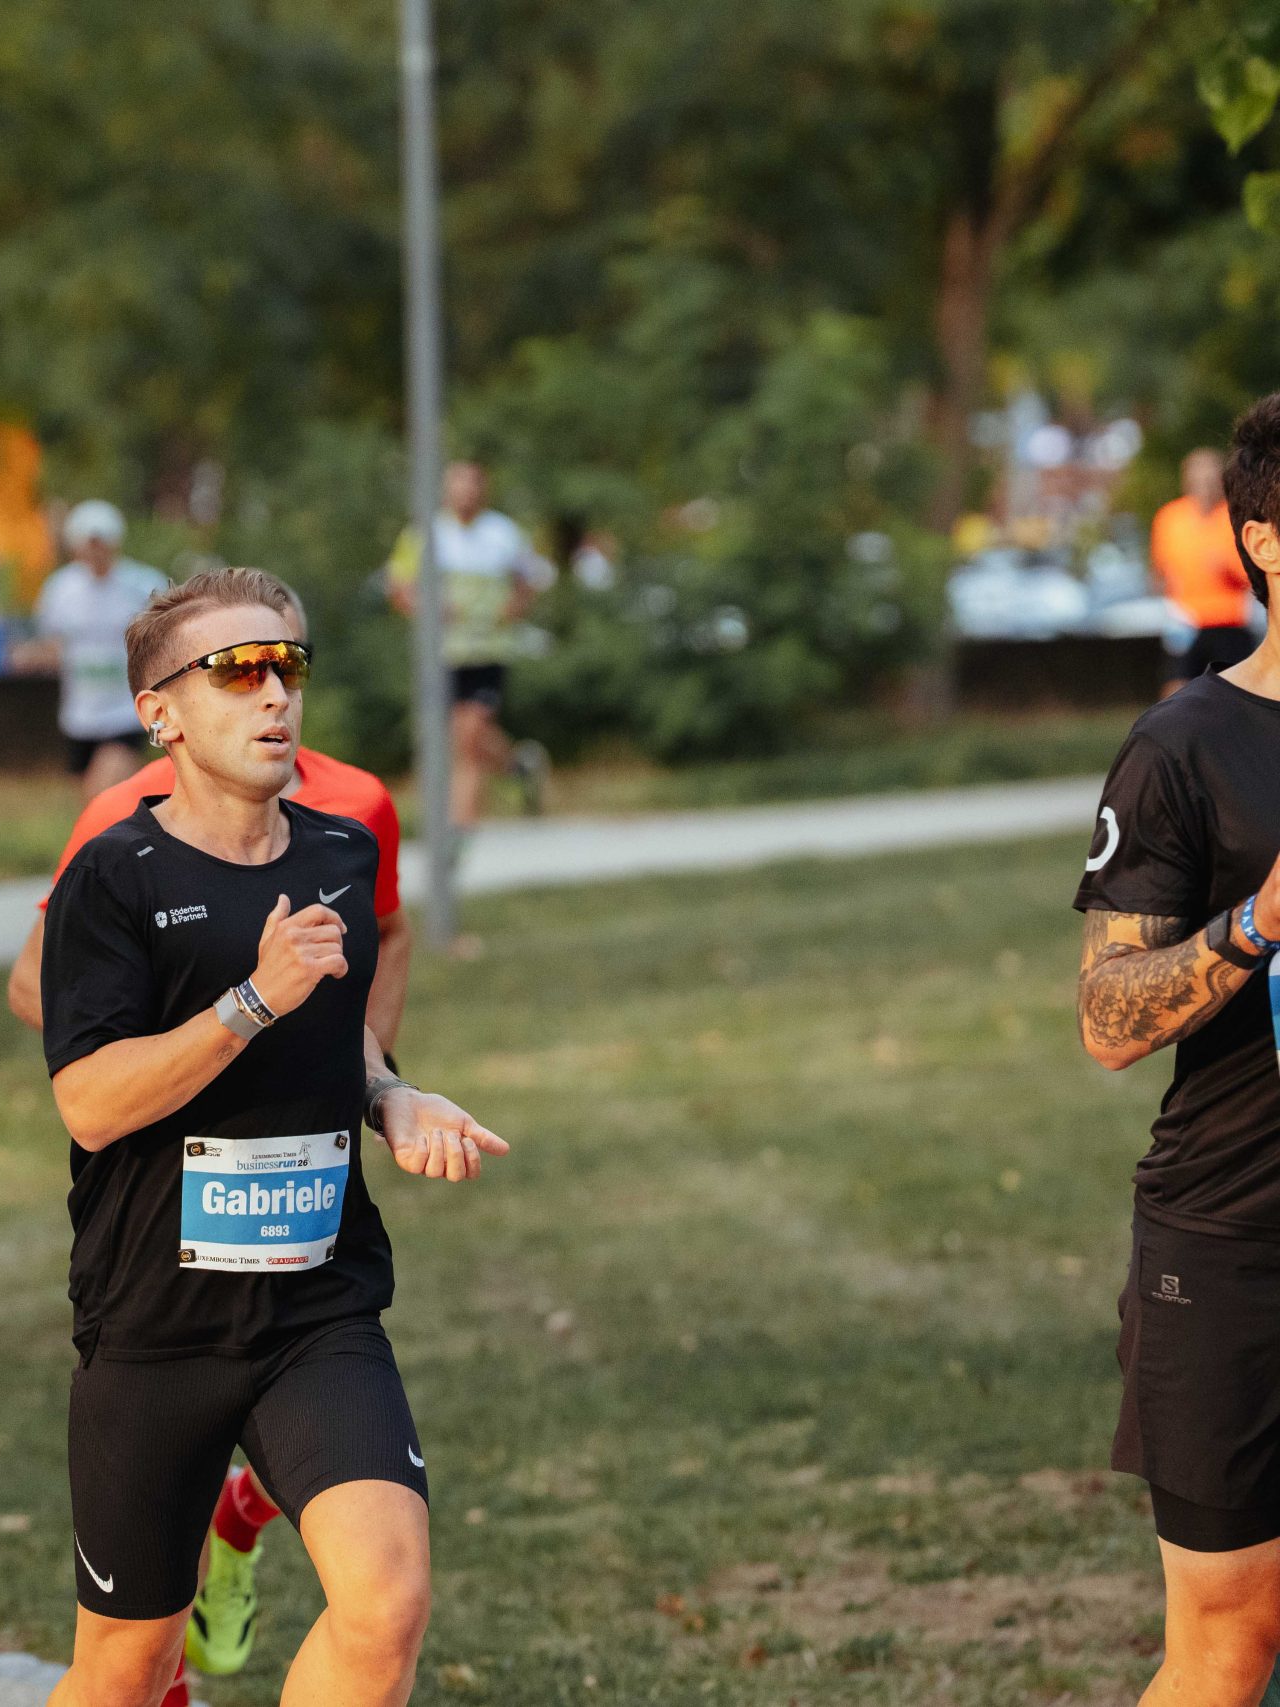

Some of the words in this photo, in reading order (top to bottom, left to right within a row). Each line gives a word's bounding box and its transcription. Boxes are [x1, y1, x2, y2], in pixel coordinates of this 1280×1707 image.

[170, 905, 206, 917] Söderberg
[202, 1177, 336, 1216] Gabriele
[260, 1224, 290, 1237] 6893
[195, 1255, 238, 1264] UXEMBOURG
